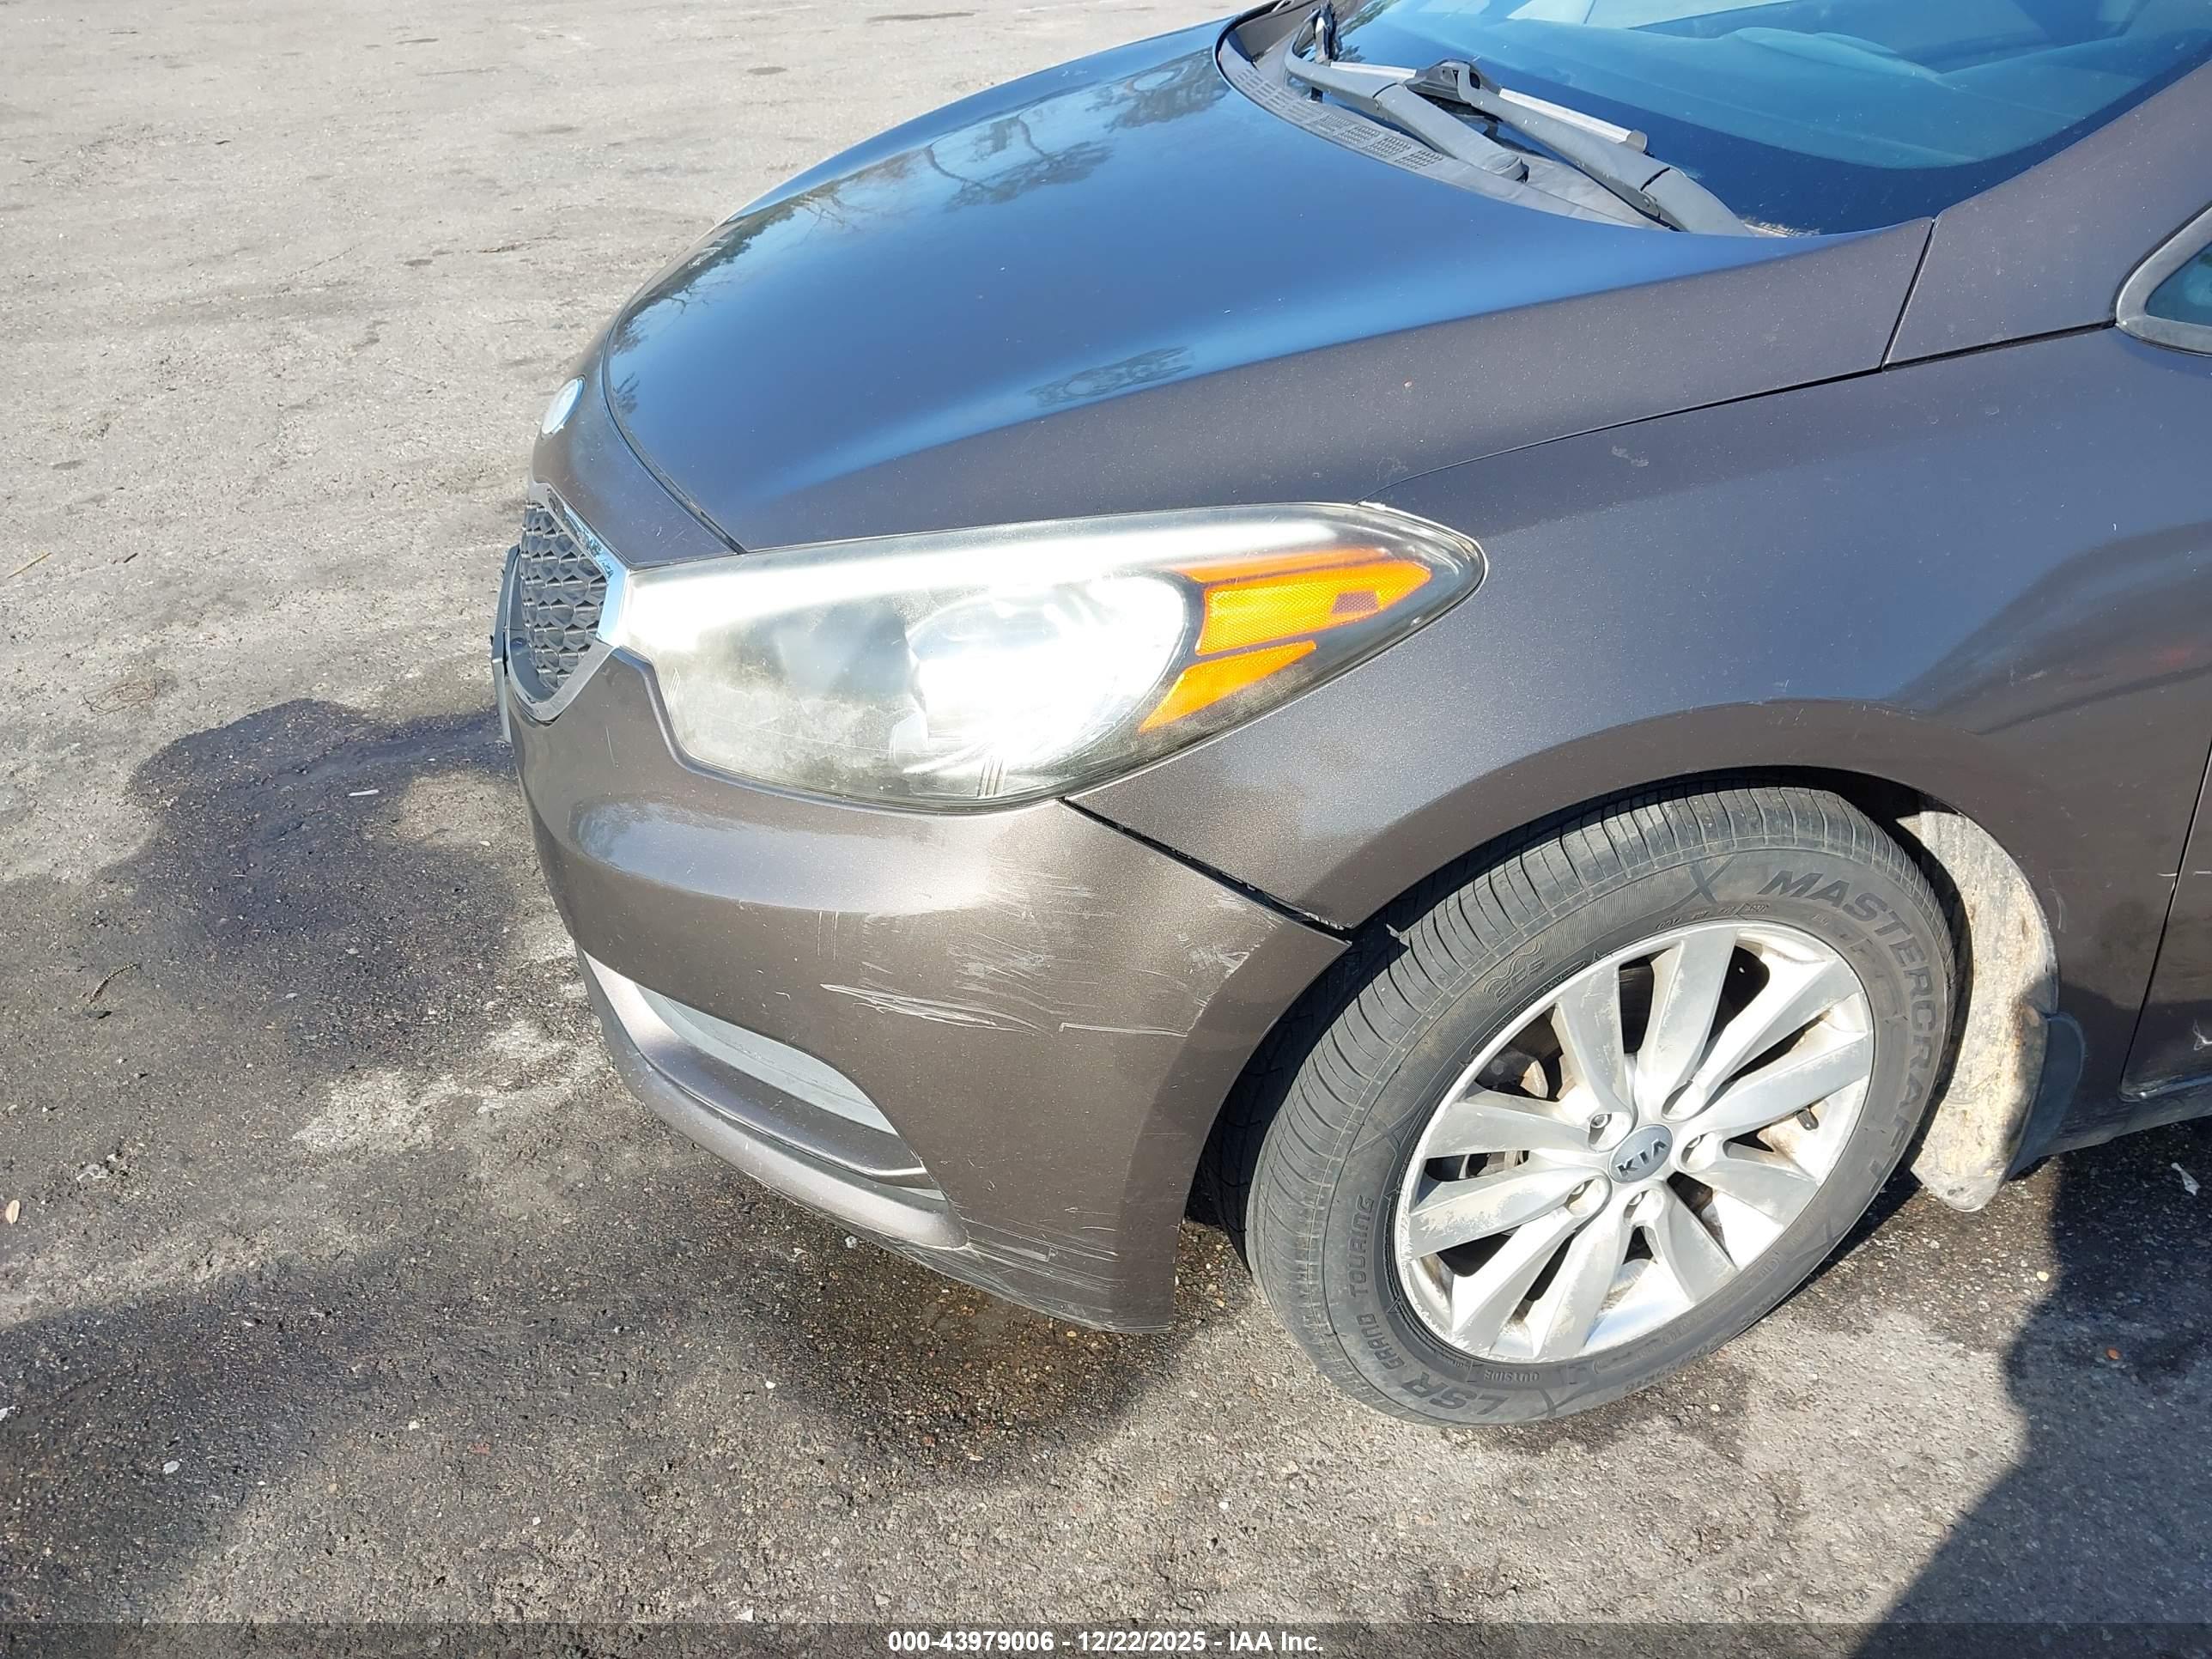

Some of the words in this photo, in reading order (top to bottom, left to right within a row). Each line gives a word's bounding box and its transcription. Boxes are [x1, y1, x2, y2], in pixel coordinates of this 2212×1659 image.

[1757, 870, 1937, 1194] MASTERCRAFT
[1614, 1139, 1668, 1177] KIA
[1347, 1194, 1374, 1297] TOURING
[1356, 1313, 1405, 1370] GRAND
[1401, 1372, 1509, 1415] LSR
